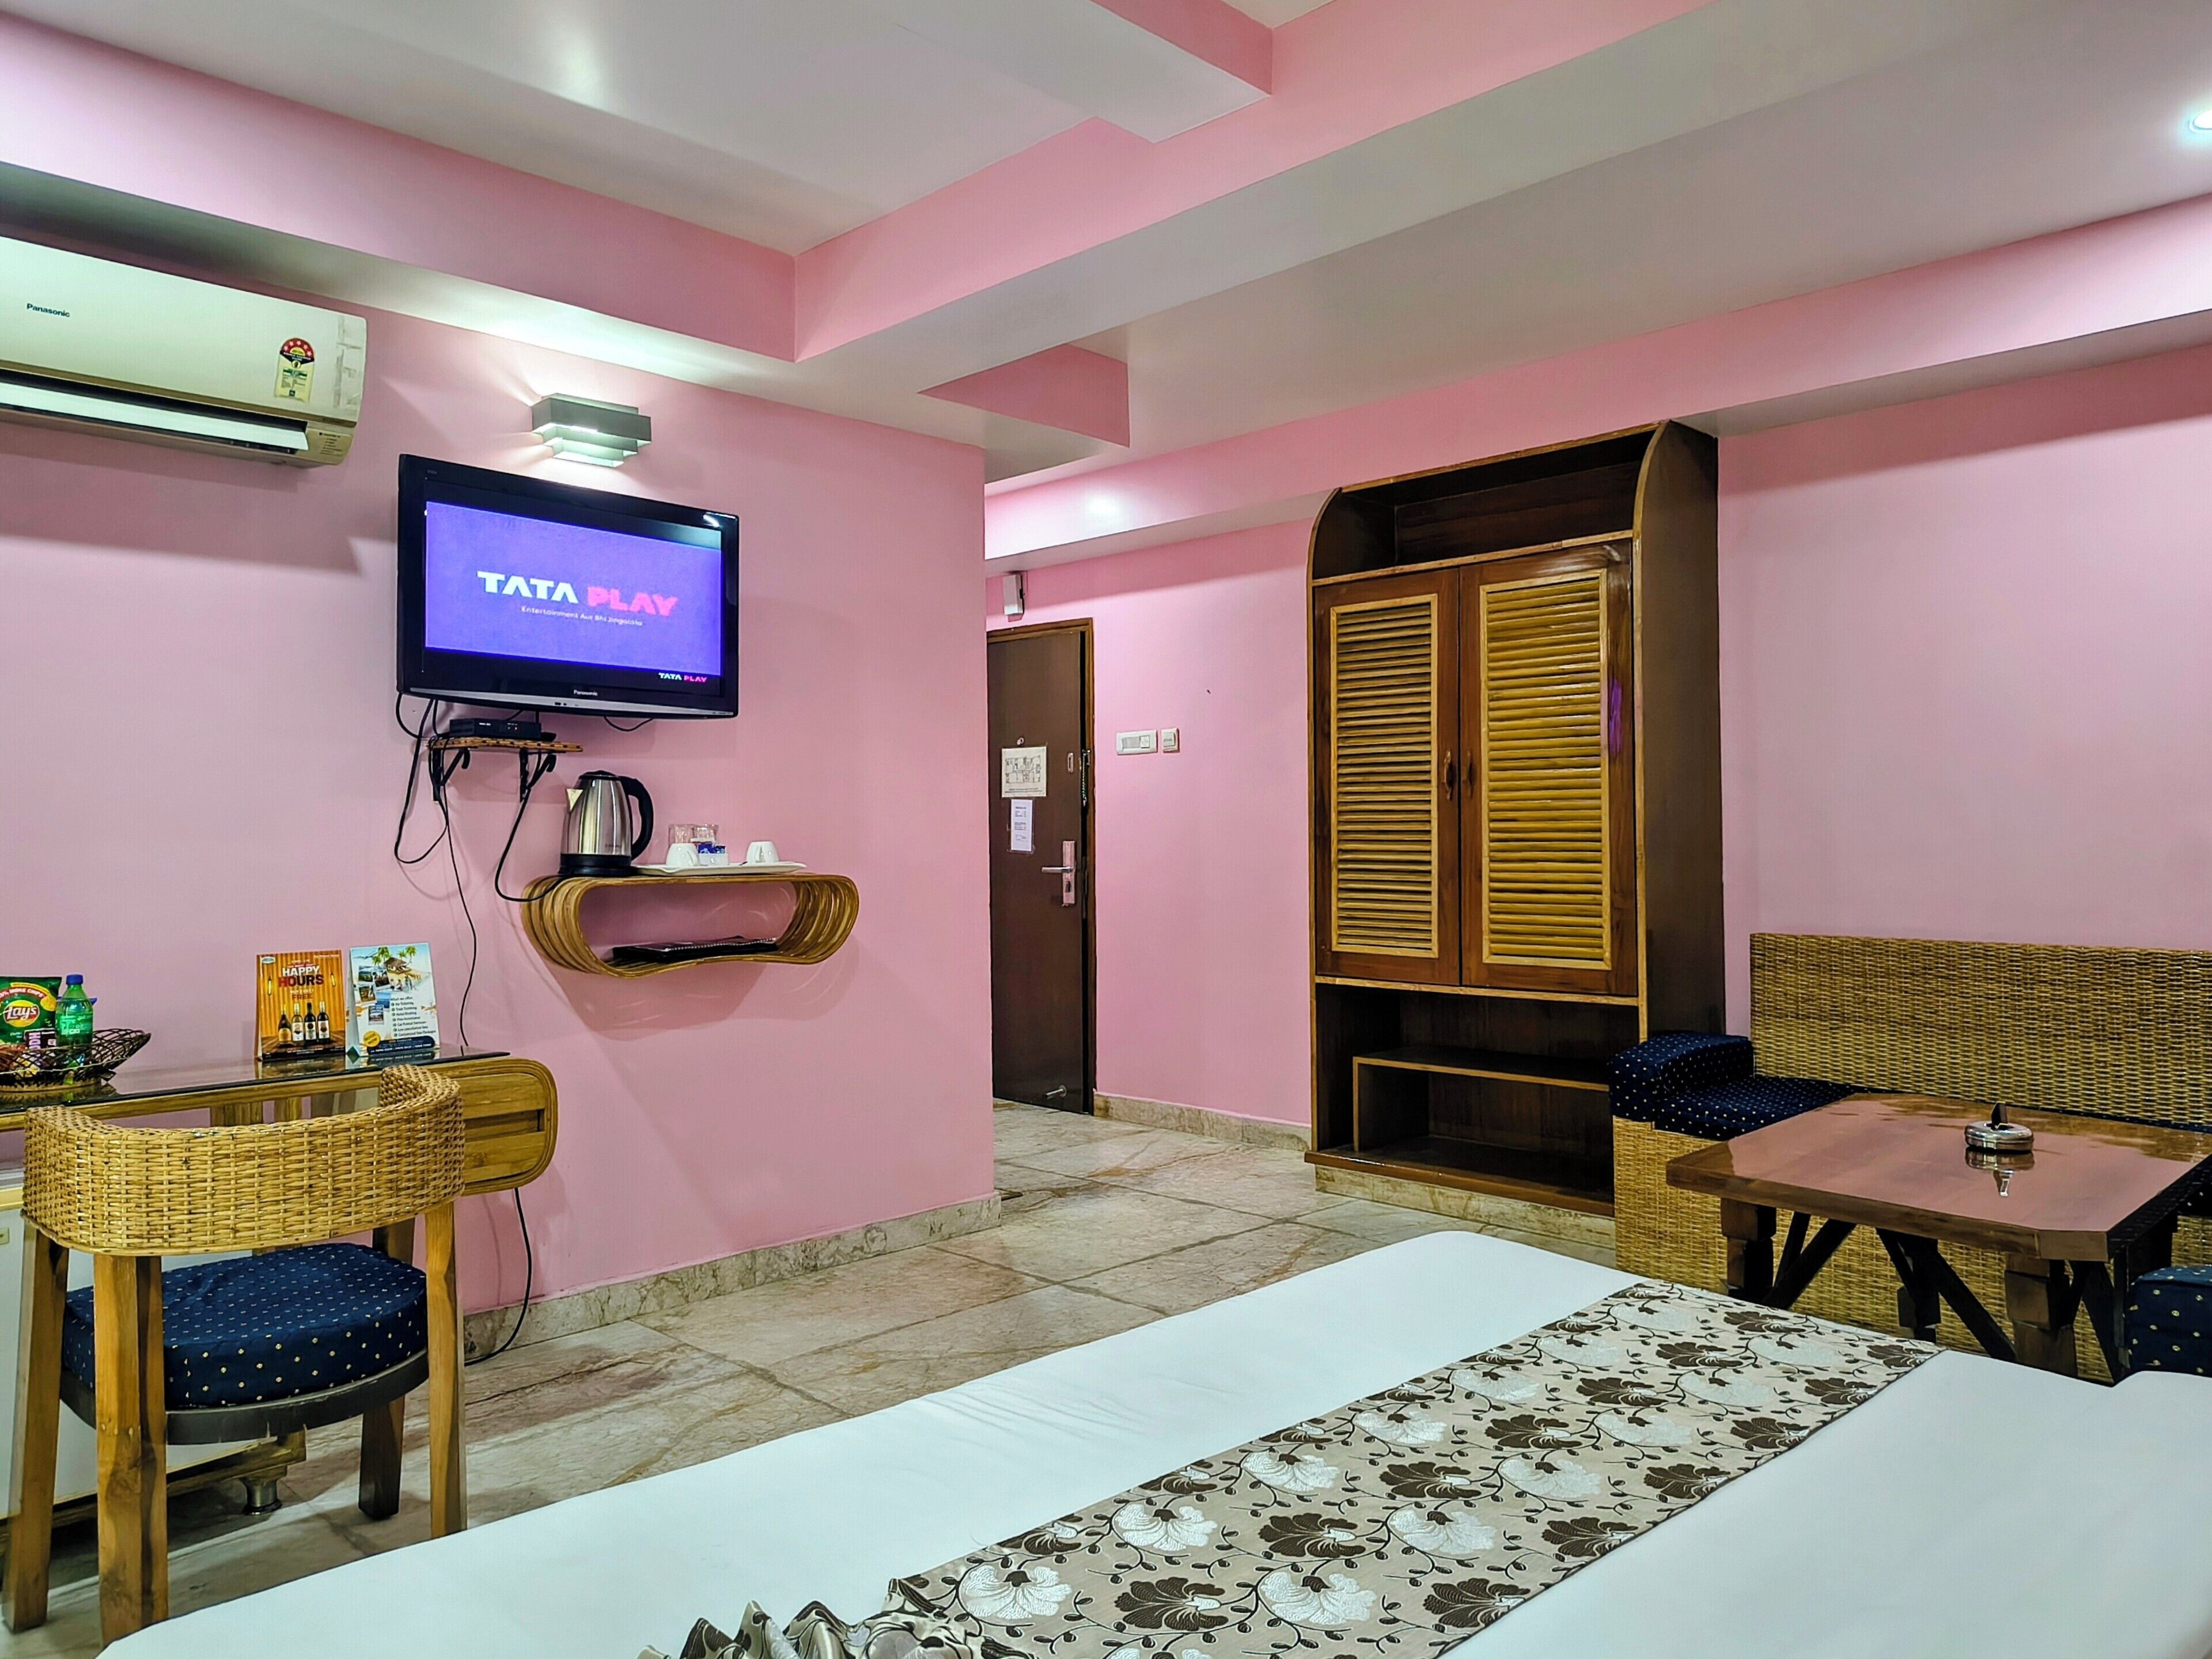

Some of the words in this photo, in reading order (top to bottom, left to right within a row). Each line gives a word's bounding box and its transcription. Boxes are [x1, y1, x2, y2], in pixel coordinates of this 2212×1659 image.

[26, 303, 70, 317] Panasonic
[477, 571, 579, 604] TATA
[587, 586, 679, 616] PLAY
[521, 605, 578, 619] Entertainment
[658, 672, 682, 680] TATA
[684, 675, 707, 683] PLAY
[282, 965, 320, 976] HAPPY
[278, 974, 324, 987] HOURS
